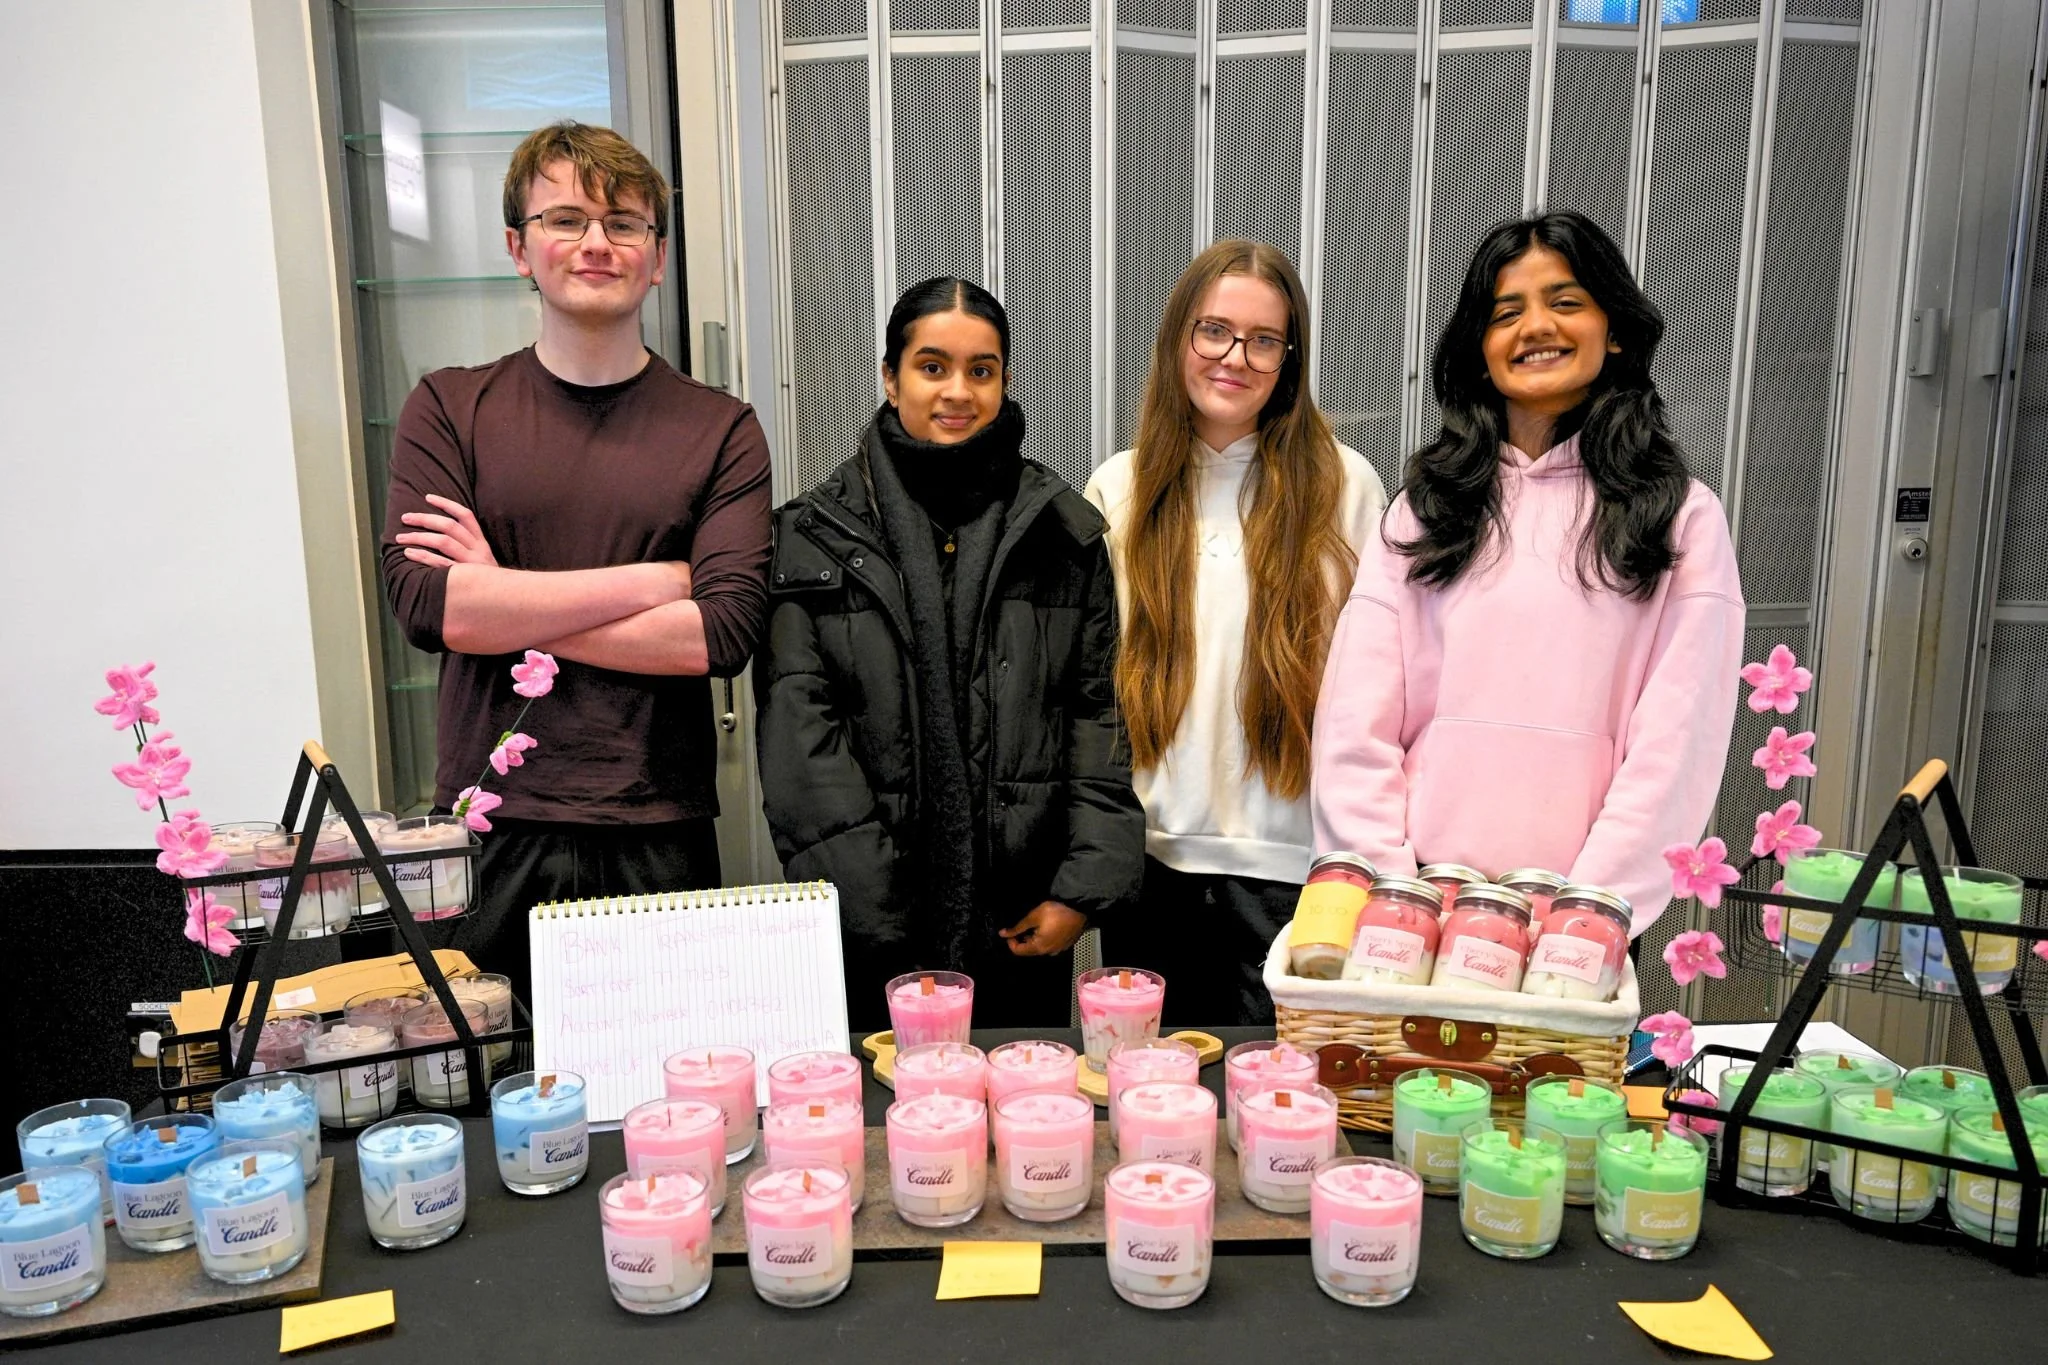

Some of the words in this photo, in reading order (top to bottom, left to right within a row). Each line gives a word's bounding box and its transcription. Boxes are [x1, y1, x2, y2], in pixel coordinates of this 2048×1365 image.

[560, 931, 622, 964] BANK
[1367, 942, 1410, 964] Candle
[1463, 953, 1508, 979] Candle
[1543, 950, 1590, 970] Candle
[543, 1140, 562, 1149] Blue
[544, 1139, 585, 1163] Candle
[1023, 1163, 1072, 1182] Candle
[1269, 1156, 1317, 1173] Candle
[907, 1167, 954, 1186] Candle
[122, 1192, 147, 1202] Blue
[145, 1190, 183, 1204] Lagoon
[411, 1191, 432, 1201] Blue
[414, 1186, 460, 1215] Candle
[126, 1198, 181, 1219] Candle
[216, 1217, 239, 1228] Blue
[240, 1206, 279, 1226] Lagoon
[1639, 1210, 1690, 1229] Candle
[221, 1217, 279, 1244] Candle
[1473, 1206, 1526, 1234] Candle
[13, 1252, 39, 1263] Blue
[40, 1239, 81, 1260] Lagoon
[611, 1250, 656, 1274] Candle
[765, 1245, 817, 1265] Candle
[1127, 1240, 1181, 1262] Candle
[1344, 1242, 1398, 1263] Candle
[18, 1250, 79, 1280] Candle
